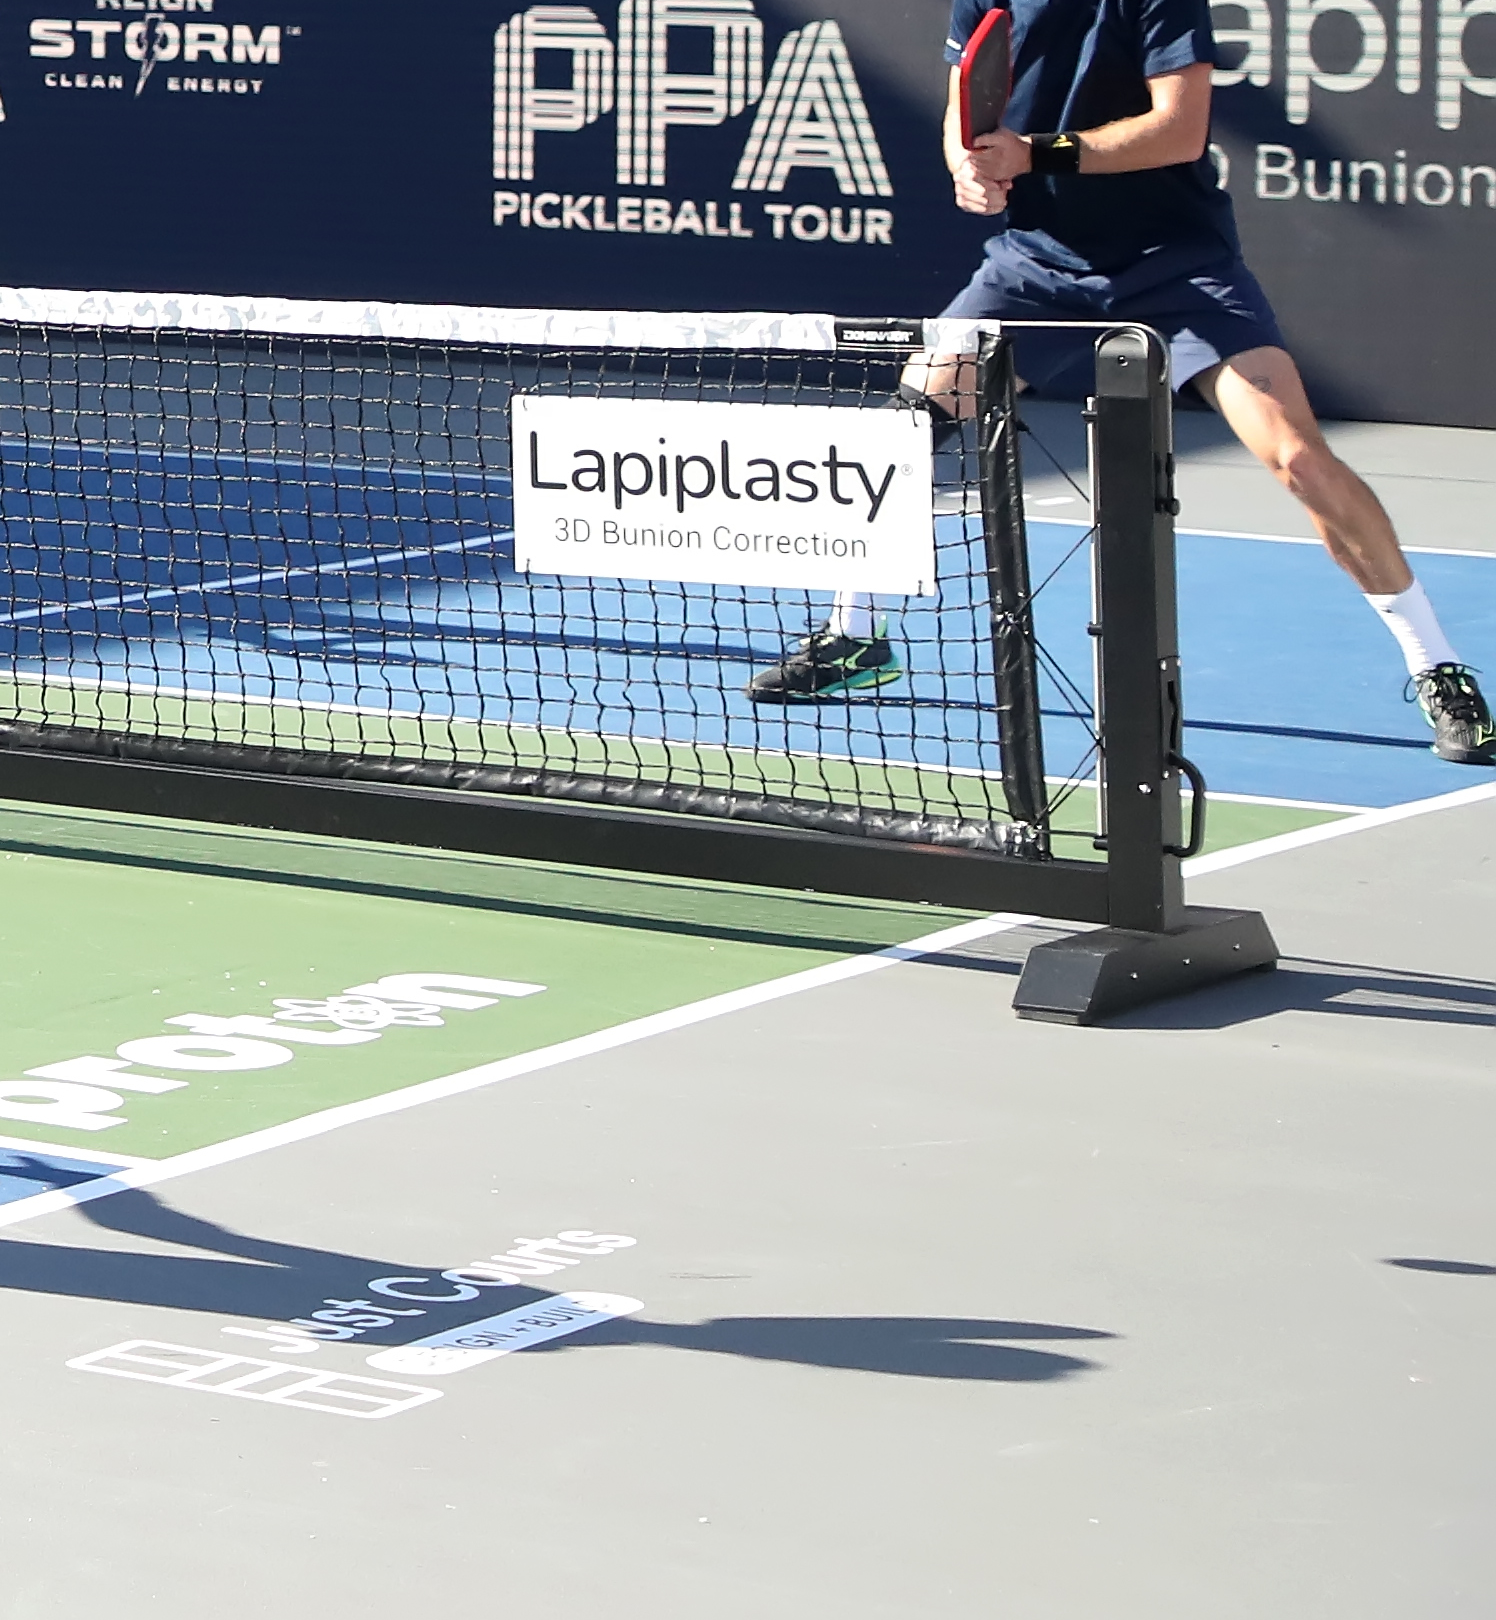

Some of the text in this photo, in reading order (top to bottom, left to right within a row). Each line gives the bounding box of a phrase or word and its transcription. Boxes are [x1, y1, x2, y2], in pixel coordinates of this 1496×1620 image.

[29, 18, 282, 64] STORM
[45, 72, 264, 94] CLEAN ENERGY
[493, 190, 893, 245] PICKLEBALL TOUR
[530, 430, 897, 523] Lapiplasty
[555, 517, 868, 558] 3D Bunion Correction
[221, 1230, 638, 1354] Just Courts
